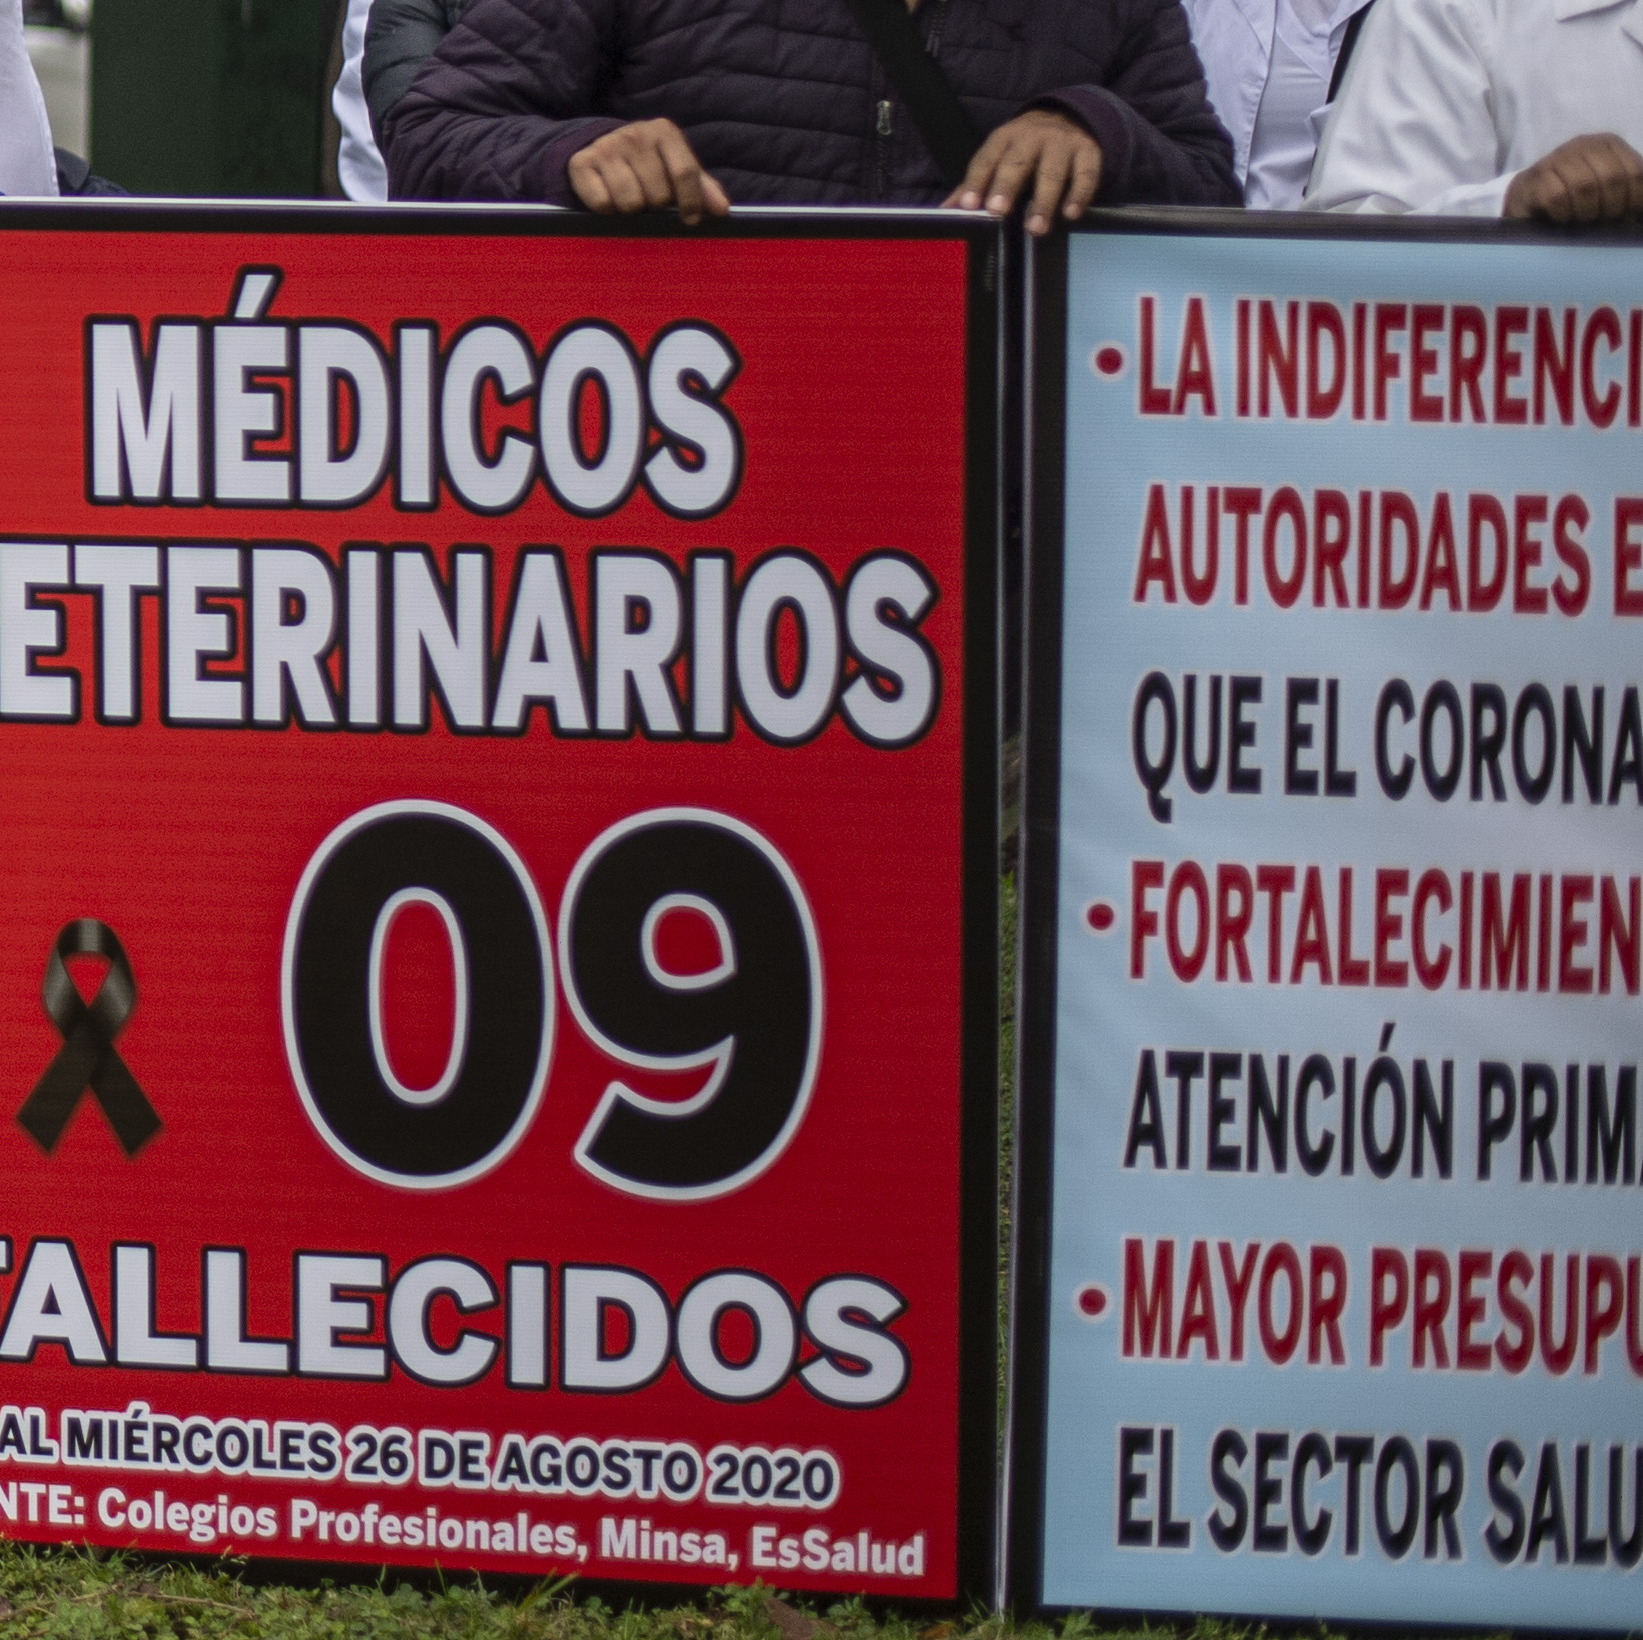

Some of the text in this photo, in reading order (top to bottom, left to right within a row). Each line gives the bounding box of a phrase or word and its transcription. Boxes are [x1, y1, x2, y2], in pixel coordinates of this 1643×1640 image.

[87, 270, 741, 514] MÉDICOS
[1138, 295, 1643, 430] LA INDIFERENCI
[1131, 482, 1593, 619] AUTORIDADES
[1131, 669, 1643, 825] QUE EL CORONA
[1129, 859, 1643, 997] FORTALECIMIEN
[281, 798, 824, 1201] 09
[1123, 1021, 1643, 1188] ATENCIÓN PRIM
[1120, 1237, 1347, 1367] MAYOR
[63, 1403, 339, 1476] MIÉRCOLES
[348, 1428, 411, 1481] 26
[421, 1432, 487, 1484] DE
[495, 1438, 700, 1495] AGOSTO
[709, 1448, 837, 1504] 2020
[1116, 1426, 1643, 1570] EL SECTOR SALU
[97, 1486, 278, 1543] Colegios
[290, 1498, 589, 1563] Profesionales,
[600, 1516, 740, 1572] Minsa,
[750, 1524, 926, 1577] EsSalud
